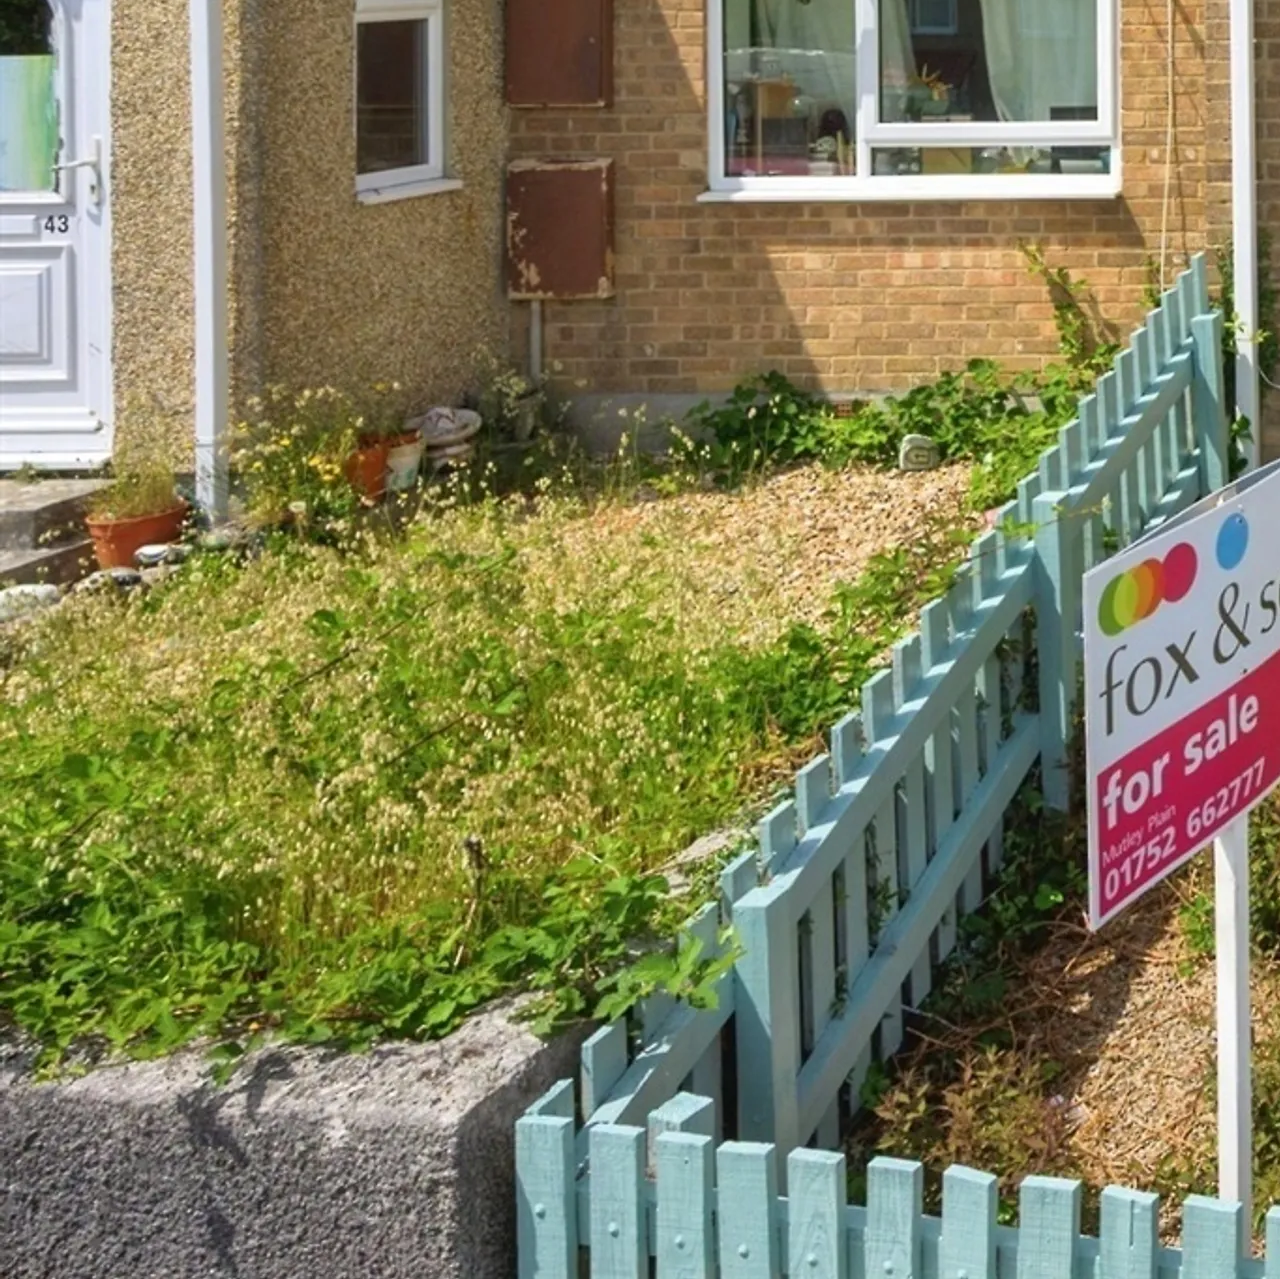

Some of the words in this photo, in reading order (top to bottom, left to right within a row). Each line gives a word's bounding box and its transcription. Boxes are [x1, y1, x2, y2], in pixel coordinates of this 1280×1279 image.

[44, 214, 69, 233] 43
[1099, 631, 1200, 737] fox
[1212, 582, 1250, 665] &
[1103, 752, 1170, 830] for
[1184, 693, 1259, 777] sale
[1104, 825, 1177, 901] 01752
[1186, 756, 1266, 839] 662777
[1102, 828, 1144, 868] Mutley
[1148, 804, 1177, 833] Plain
